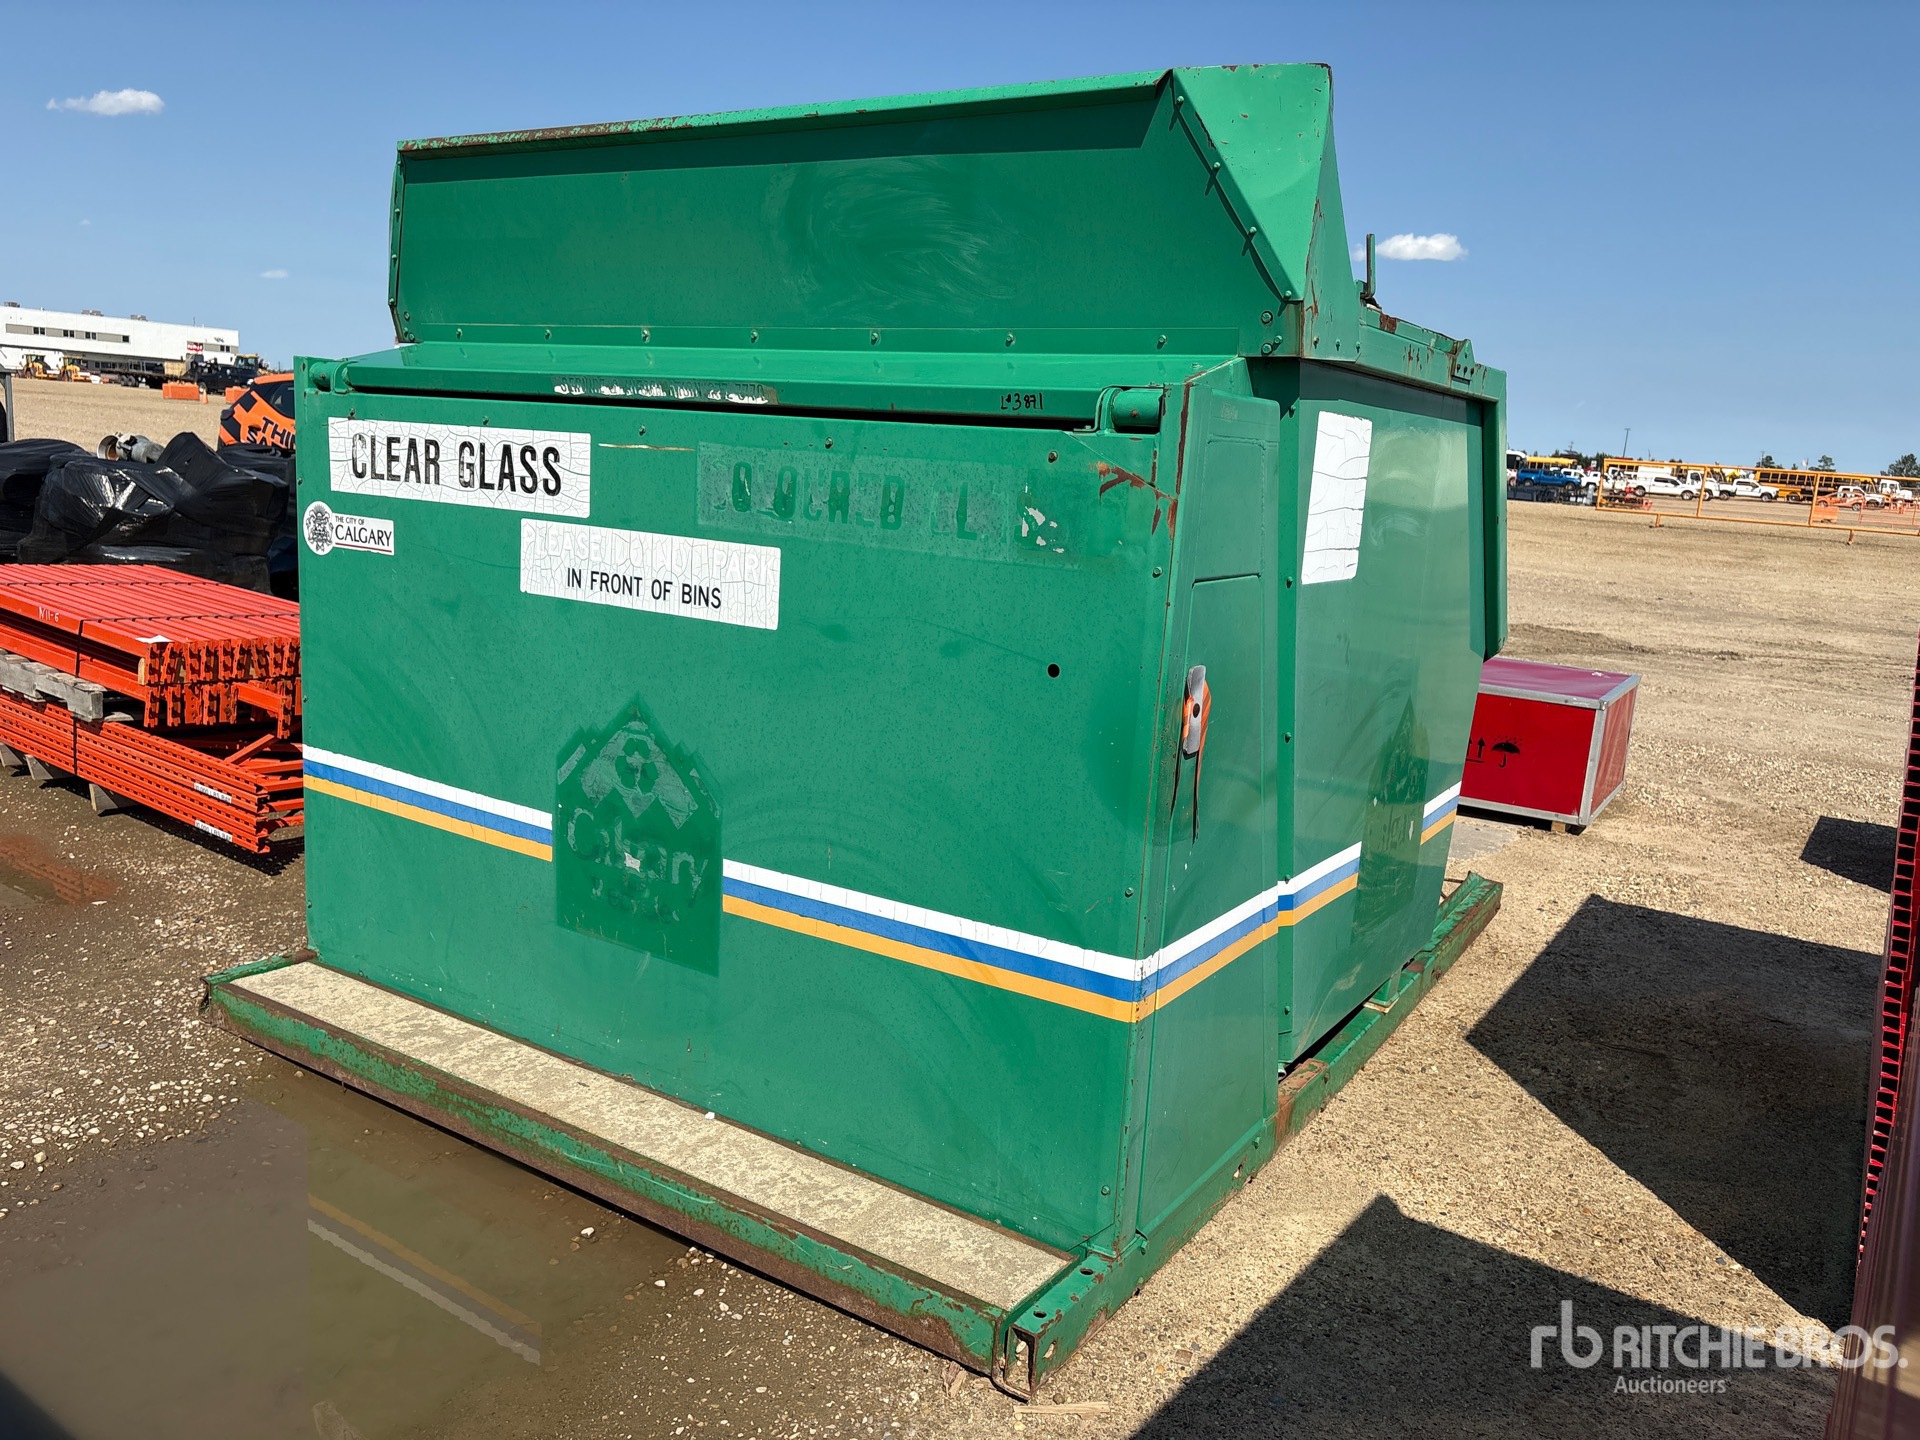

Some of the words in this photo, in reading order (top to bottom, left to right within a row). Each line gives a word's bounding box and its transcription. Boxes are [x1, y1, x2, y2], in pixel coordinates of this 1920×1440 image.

[262, 416, 296, 449] THI
[351, 433, 441, 485] CLEAR
[458, 441, 561, 497] GLASS
[335, 524, 392, 547] CALGARY
[358, 518, 365, 526] OF
[567, 567, 582, 590] IN
[590, 570, 643, 598] FRONT
[651, 578, 673, 602] OF
[681, 583, 722, 609] BINS
